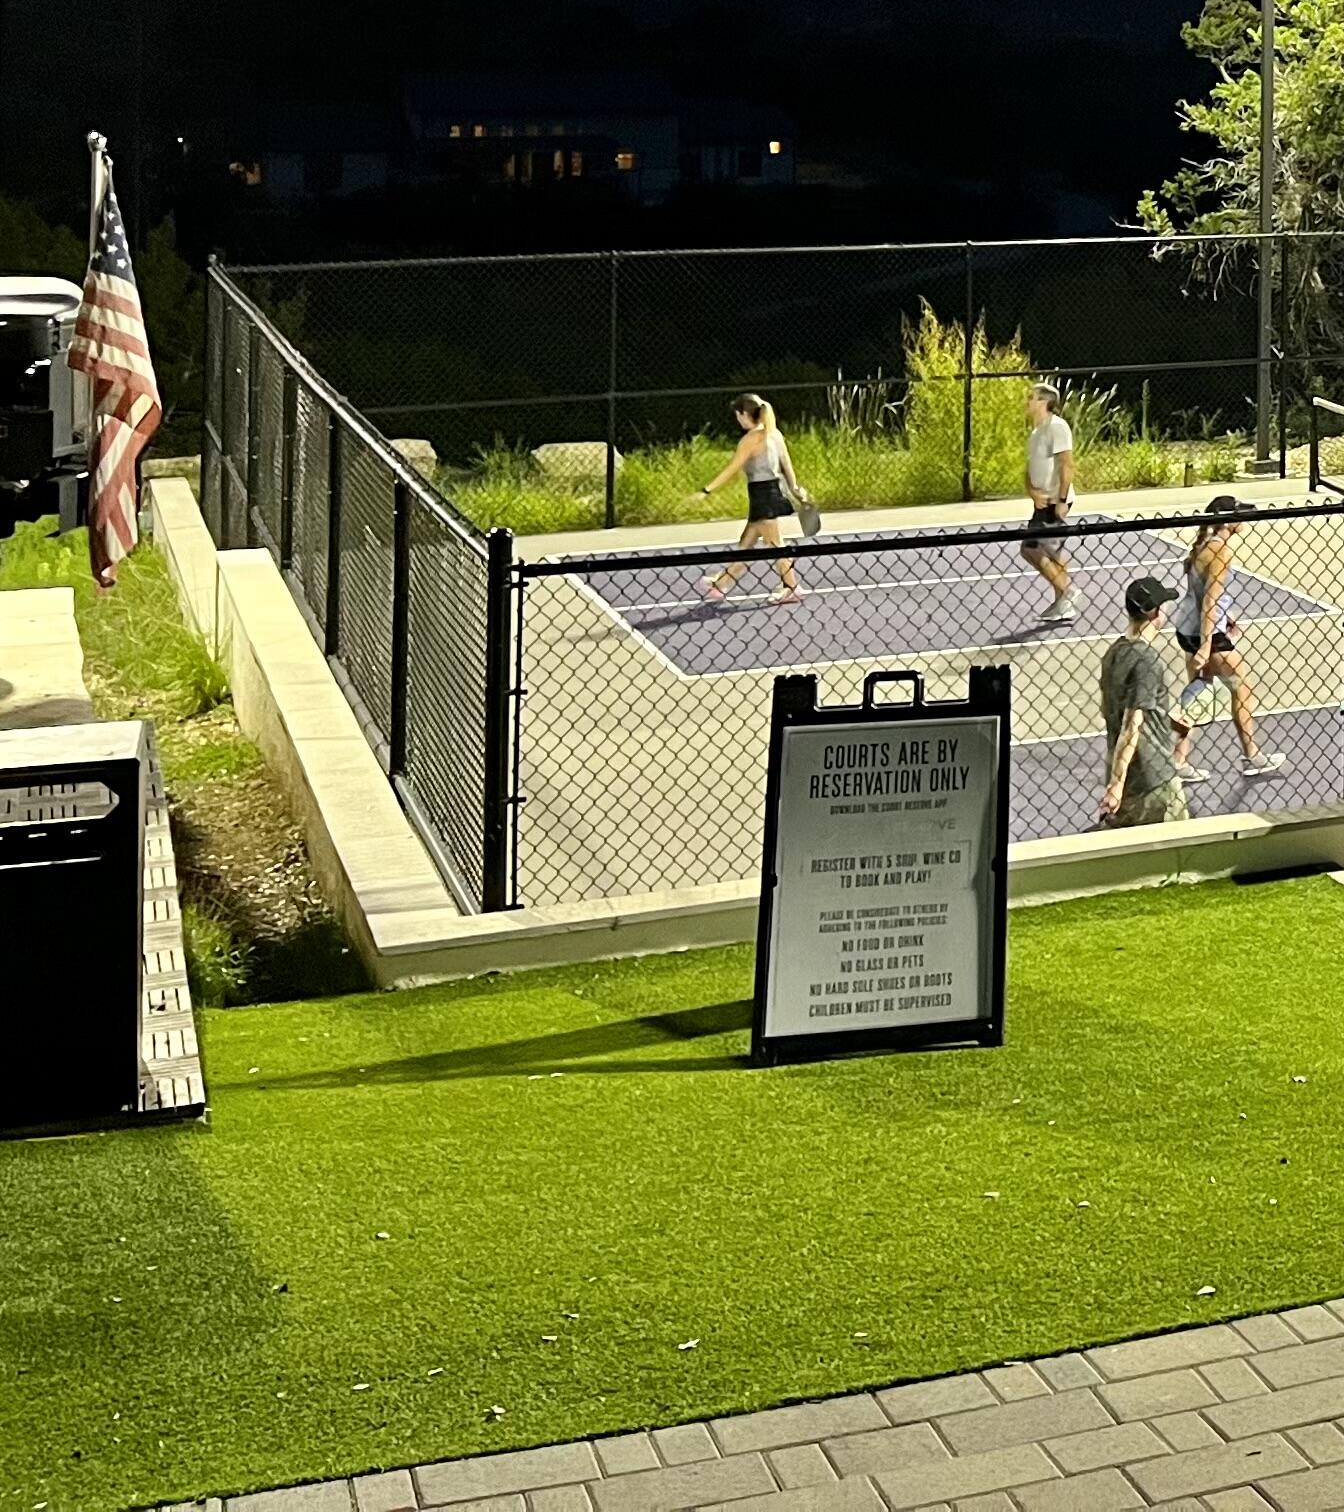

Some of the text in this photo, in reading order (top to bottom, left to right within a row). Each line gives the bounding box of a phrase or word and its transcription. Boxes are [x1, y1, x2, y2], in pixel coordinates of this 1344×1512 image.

[823, 738, 959, 770] COURTS ARE BY
[809, 765, 970, 799] RESERVATION ONLY
[810, 856, 856, 873] REGISTER
[859, 855, 883, 870] WITH
[885, 854, 892, 869] 5
[922, 850, 946, 865] WINE
[948, 849, 961, 864] CO
[840, 869, 932, 889] TO BOOK AND PLAY!
[841, 934, 925, 953] NO FOOD OR DRINK
[840, 954, 924, 973] NO GLASS OR PETS
[809, 972, 953, 997] NO HARD SOLE SHOES OR BOOTS
[808, 993, 952, 1017] CHILDREN MUST BE SUPERVISED
